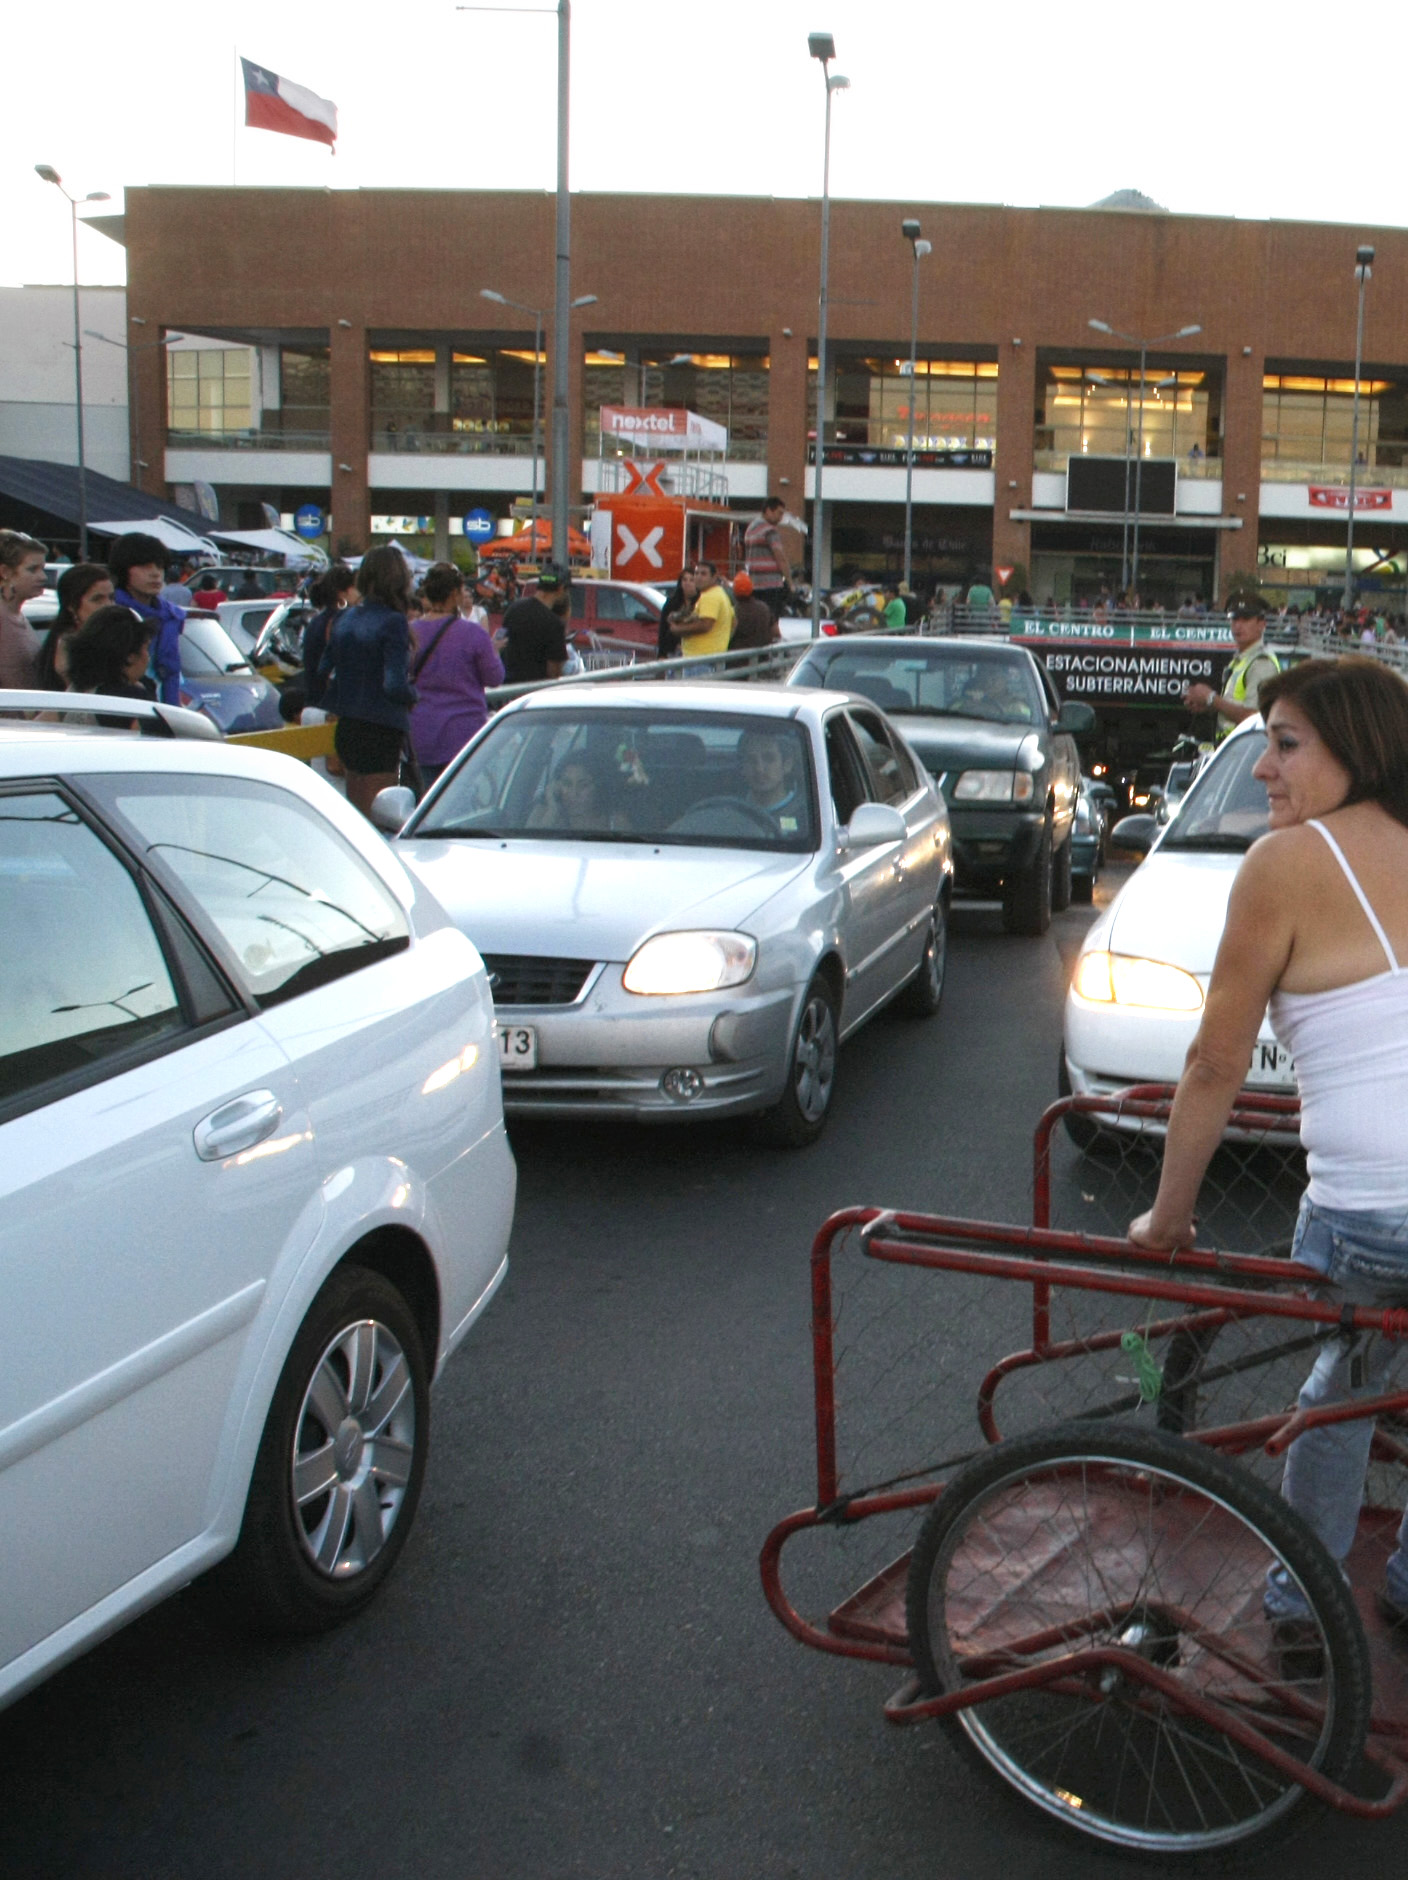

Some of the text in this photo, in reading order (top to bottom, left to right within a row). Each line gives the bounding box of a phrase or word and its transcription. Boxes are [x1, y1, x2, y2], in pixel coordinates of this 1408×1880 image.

[612, 413, 675, 432] nextel
[466, 517, 491, 531] sb
[1024, 621, 1115, 639] EL CENTRO
[1150, 624, 1171, 640] EL
[1046, 654, 1212, 676] ESTACIONAMIENTOS
